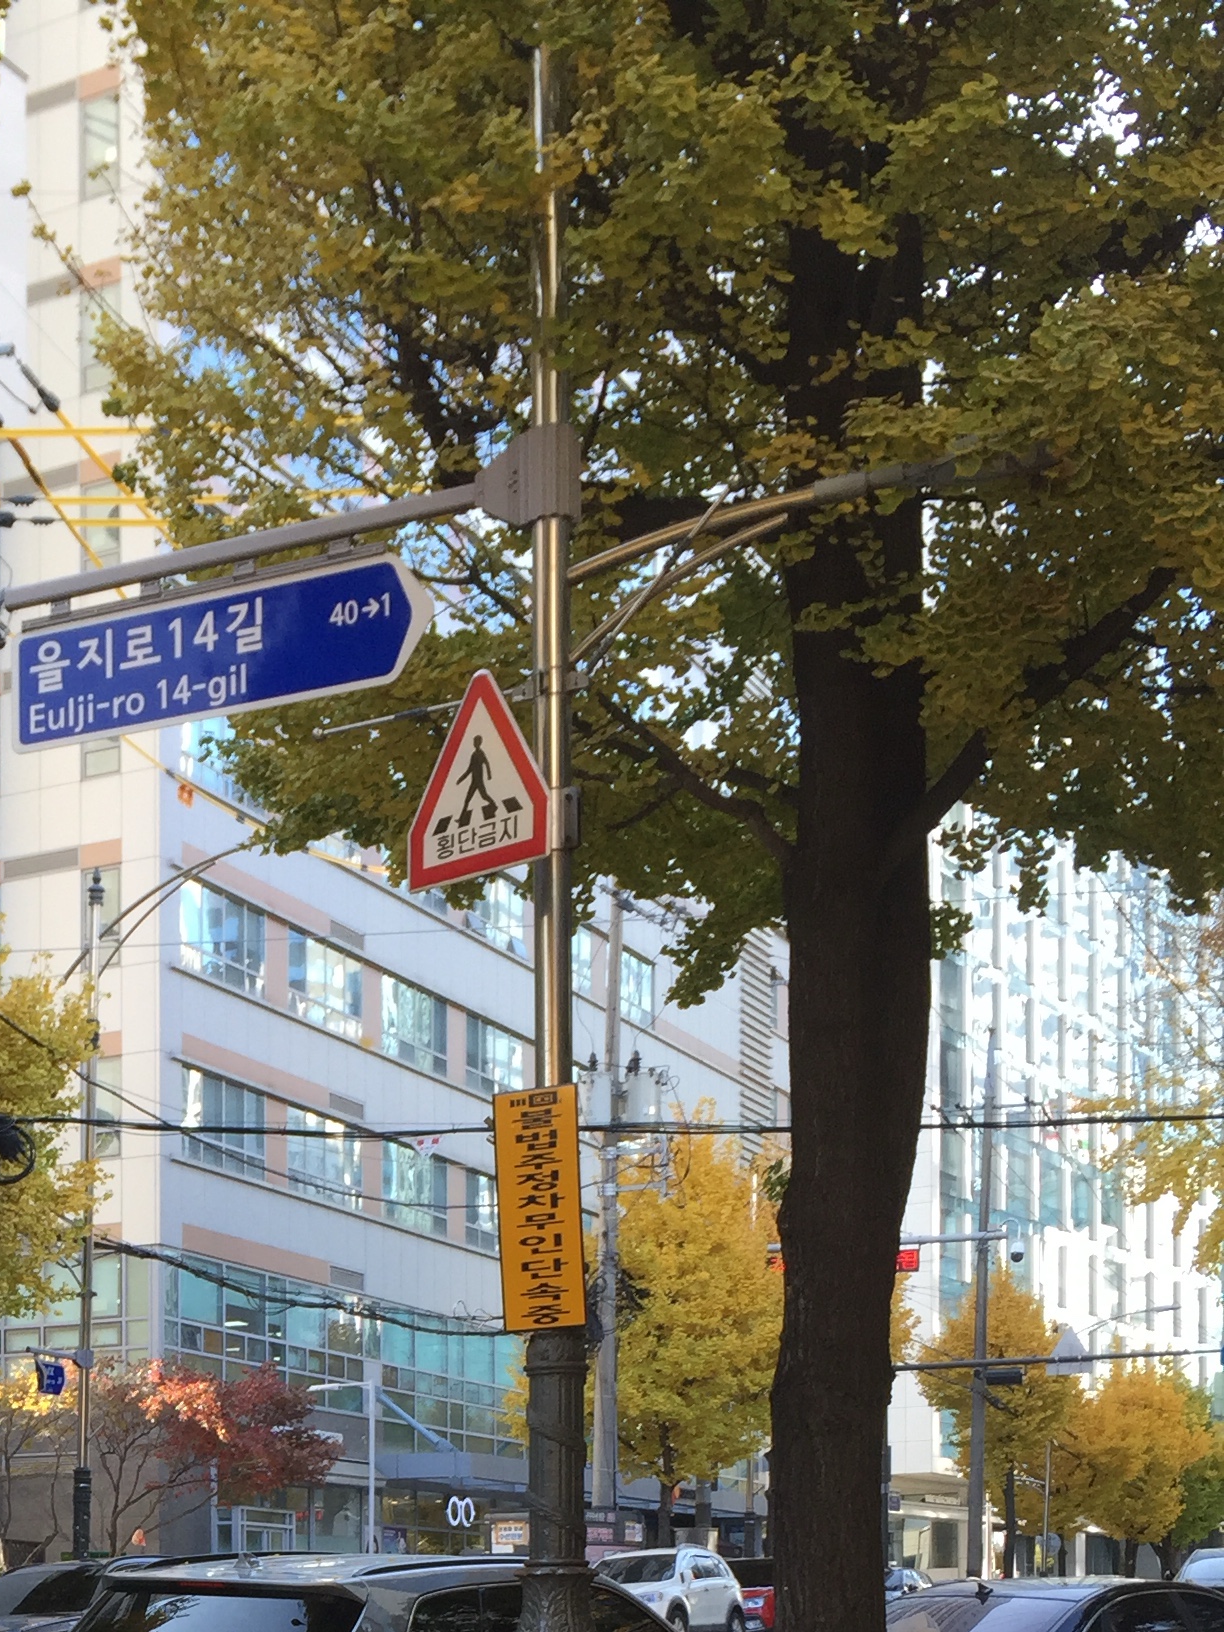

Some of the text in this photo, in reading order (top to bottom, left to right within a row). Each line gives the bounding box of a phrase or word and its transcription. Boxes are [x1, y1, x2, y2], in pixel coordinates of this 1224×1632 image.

[29, 596, 264, 694] 을지로14길
[29, 662, 248, 735] Eulji-ro 14-gil
[436, 815, 518, 860] 횡단금지
